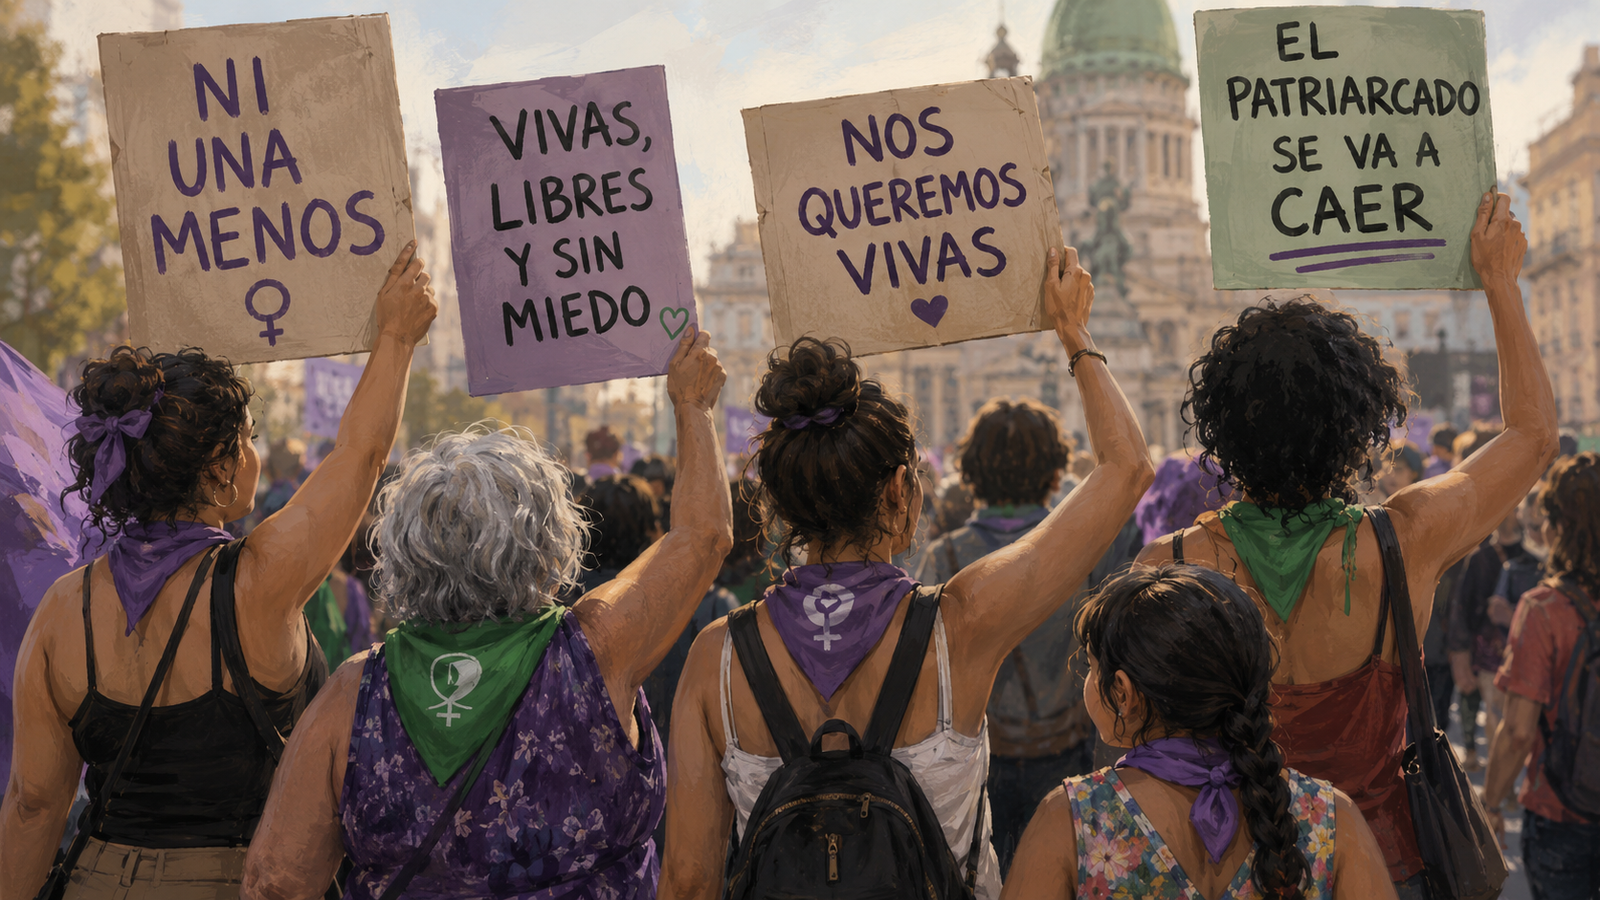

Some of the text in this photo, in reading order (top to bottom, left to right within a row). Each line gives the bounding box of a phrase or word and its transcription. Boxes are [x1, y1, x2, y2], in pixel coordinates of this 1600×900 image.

[1276, 21, 1339, 62] EL
[193, 56, 269, 122] NI
[1226, 75, 1480, 121] PATRIARCADO
[489, 101, 651, 160] VIVAS,
[841, 106, 954, 166] NOS
[1273, 131, 1440, 173] SE VA A
[168, 128, 302, 197] UNA
[491, 167, 653, 231] LIBRES
[798, 162, 1027, 239] QUEREMOS
[1271, 182, 1433, 237] CAER
[151, 190, 385, 275] MENOS
[504, 231, 623, 287] Y SIN
[836, 226, 1007, 295] VIVAS
[502, 285, 650, 346] MIEDO
